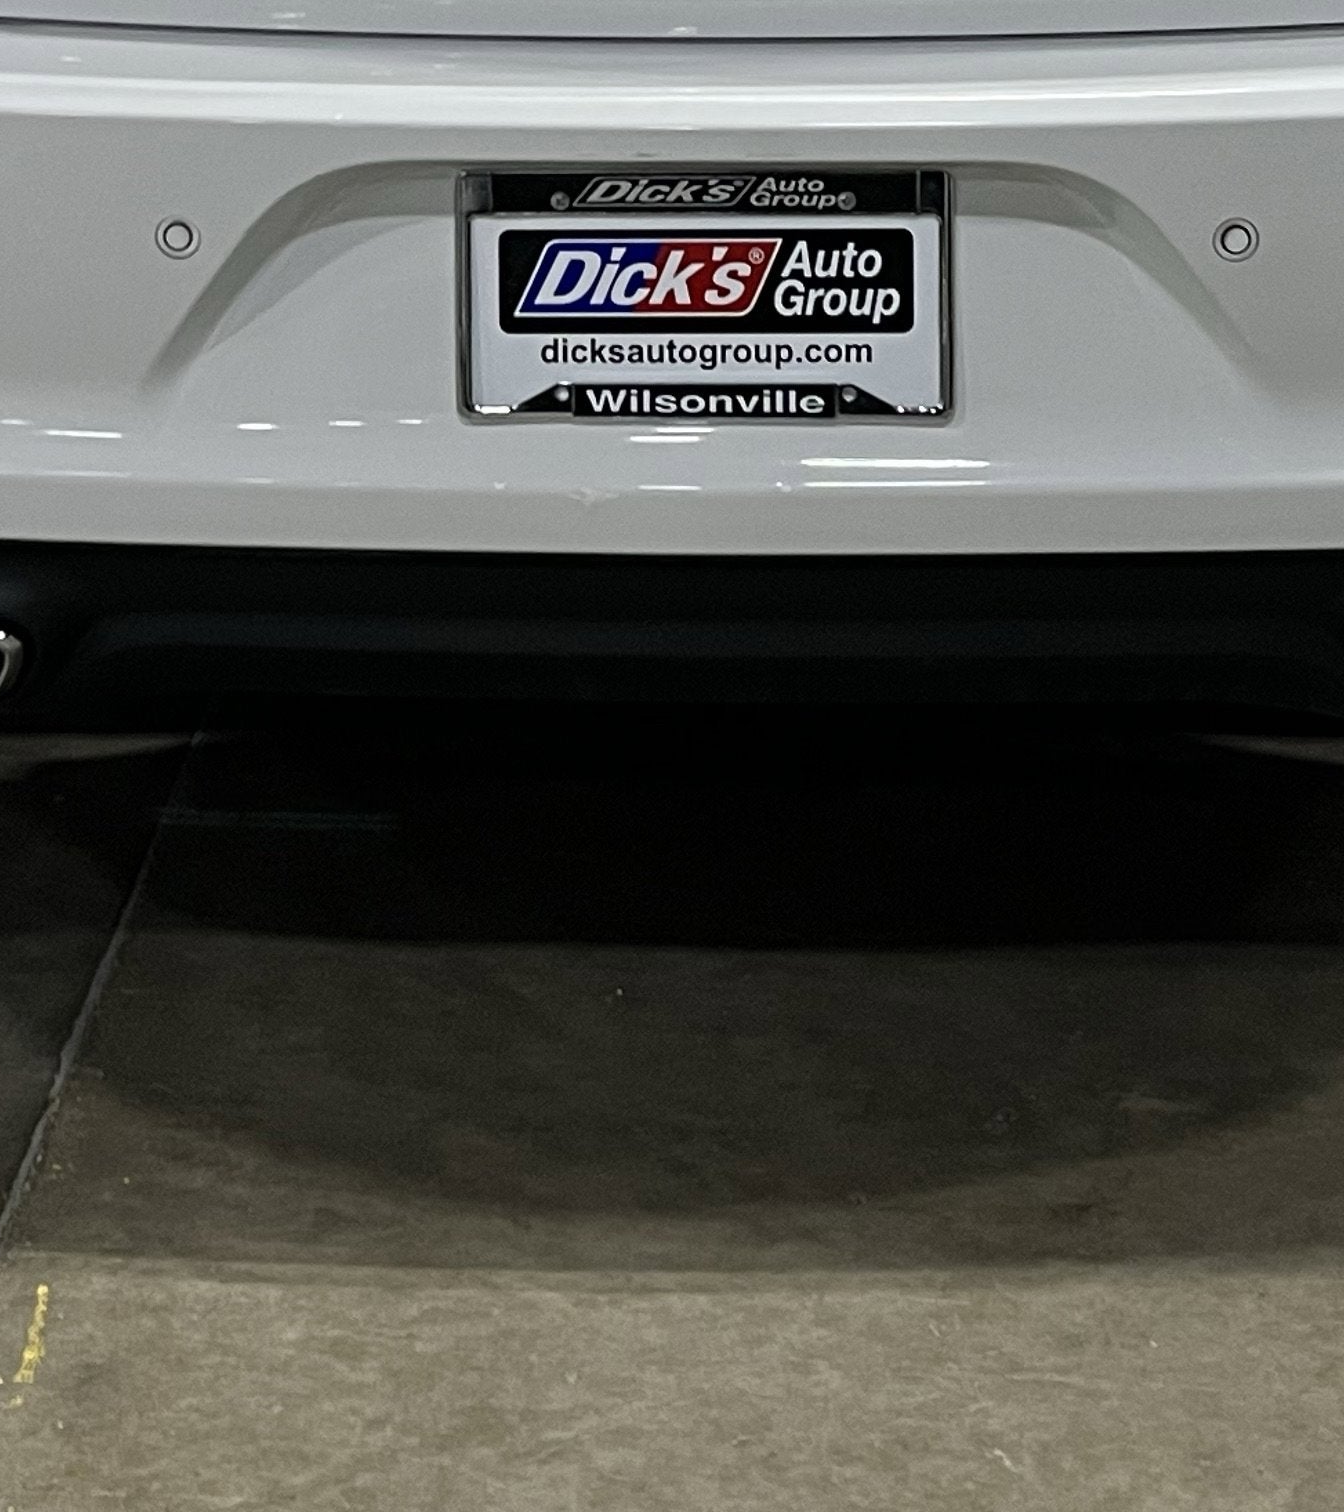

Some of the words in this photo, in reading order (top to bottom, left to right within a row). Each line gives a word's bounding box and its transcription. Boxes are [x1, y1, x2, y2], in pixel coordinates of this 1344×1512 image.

[586, 179, 735, 203] Dick's
[756, 177, 825, 193] Auto
[750, 190, 838, 209] Group
[781, 241, 883, 278] Auto
[773, 281, 902, 324] Group
[540, 337, 874, 370] dicksautogroup.com
[585, 390, 826, 414] Wilsonville
